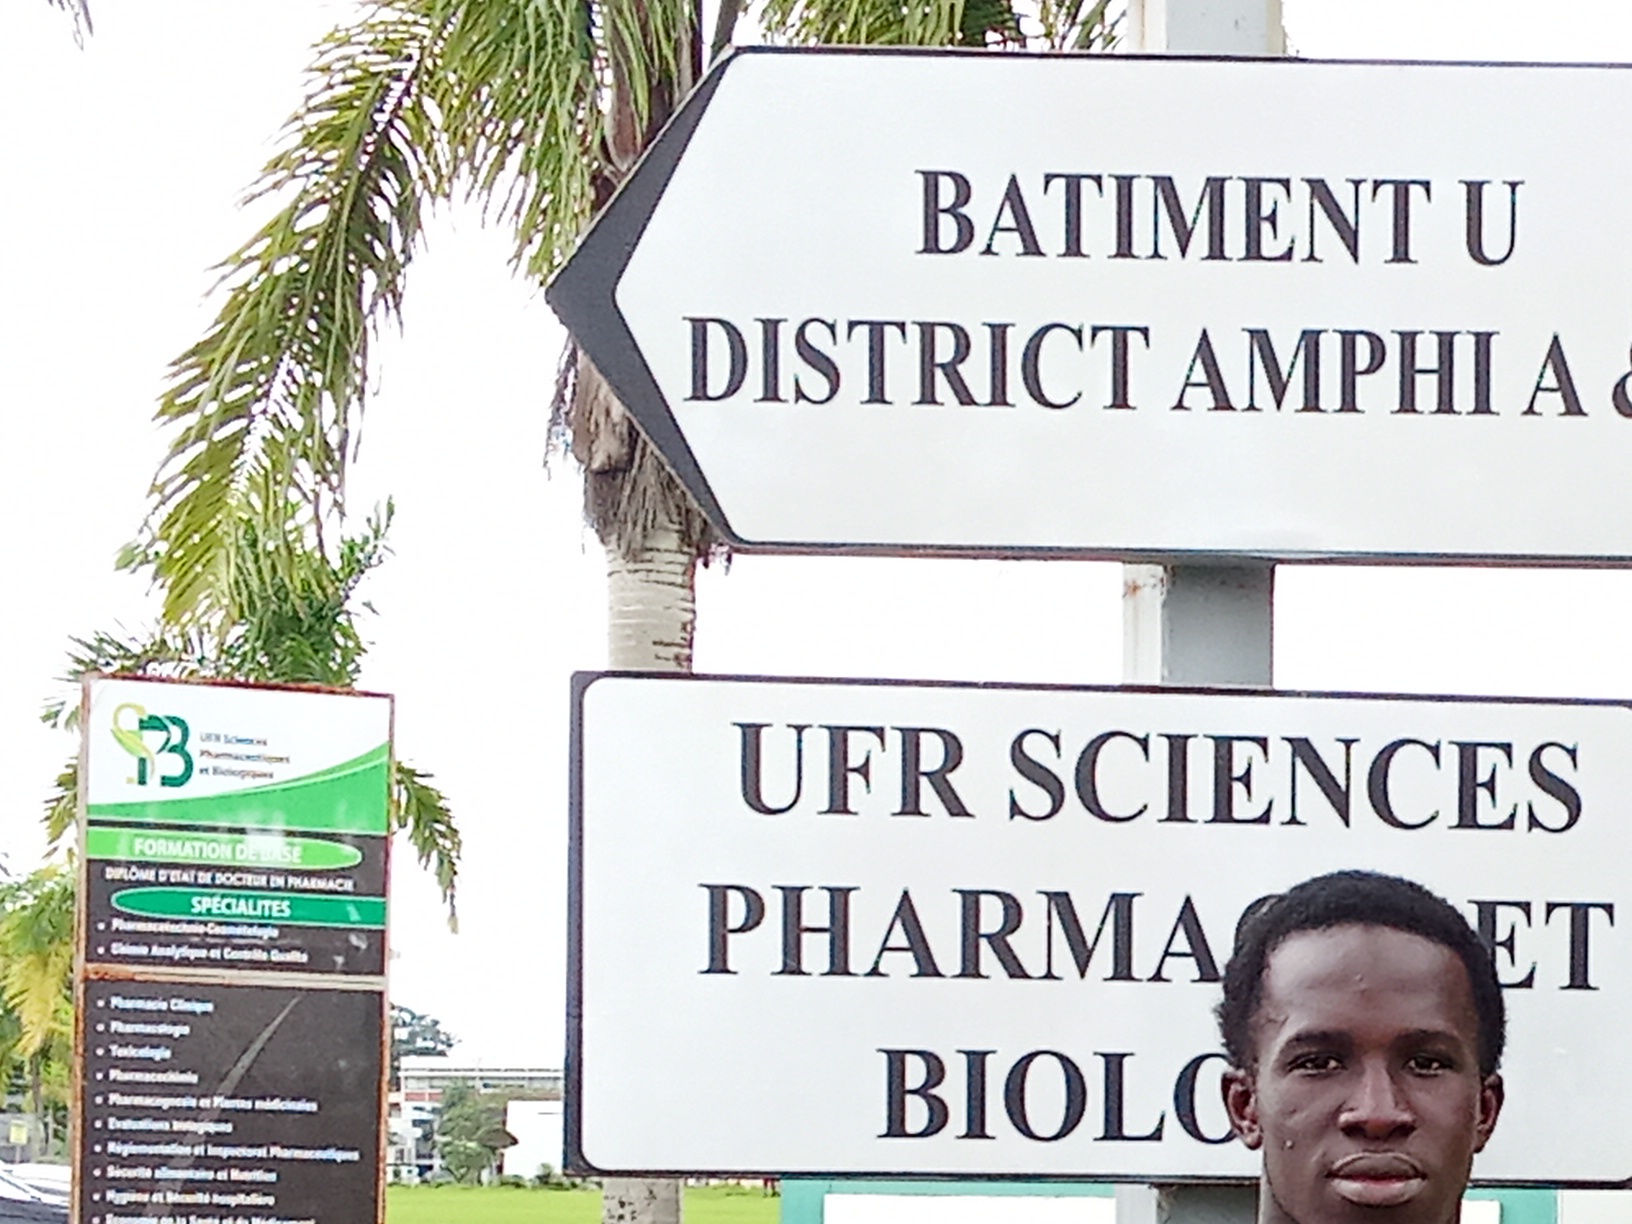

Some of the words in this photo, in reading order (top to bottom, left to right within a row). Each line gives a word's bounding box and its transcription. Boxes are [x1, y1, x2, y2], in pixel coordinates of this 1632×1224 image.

[914, 169, 1432, 265] BATIMENT
[1458, 179, 1526, 267] U
[682, 316, 1150, 411] DISTRICT
[1170, 327, 1500, 416] AMPHI
[1521, 333, 1589, 417] A
[732, 722, 976, 818] UFR
[1009, 728, 1583, 835] SCIENCES
[134, 838, 232, 860] FORMATION
[287, 875, 355, 893] PHARMACIE
[1467, 899, 1616, 992] ET
